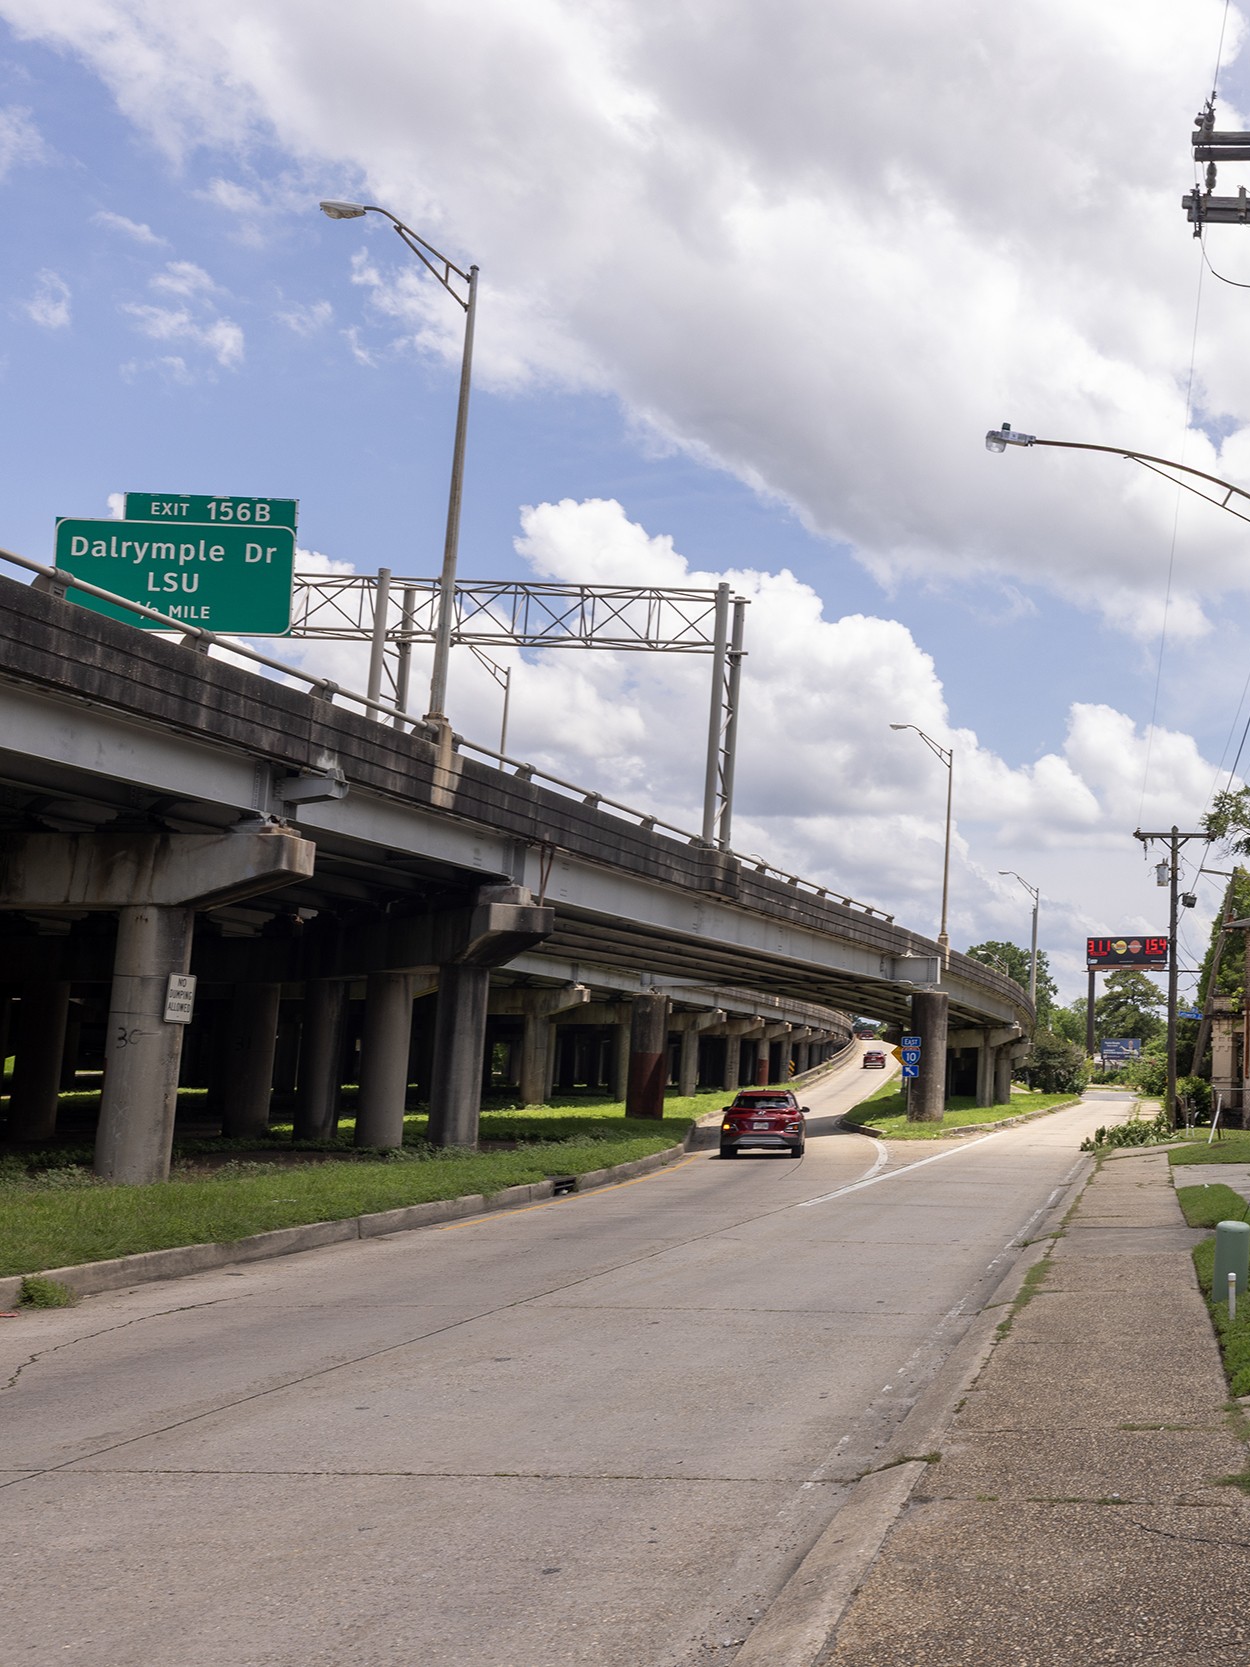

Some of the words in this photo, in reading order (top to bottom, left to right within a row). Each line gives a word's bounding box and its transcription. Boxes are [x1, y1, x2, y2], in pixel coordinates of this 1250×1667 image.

[151, 502, 190, 516] EXIT
[206, 501, 271, 522] 156B
[70, 535, 226, 566] Dalrymple
[244, 543, 278, 564] Dr
[147, 571, 200, 593] LSU
[168, 605, 211, 619] MILE
[1145, 938, 1167, 951] 154
[177, 978, 187, 988] NO
[168, 989, 192, 1000] DUMPING
[167, 1001, 191, 1013] ALLOWED
[906, 1052, 917, 1062] 10
